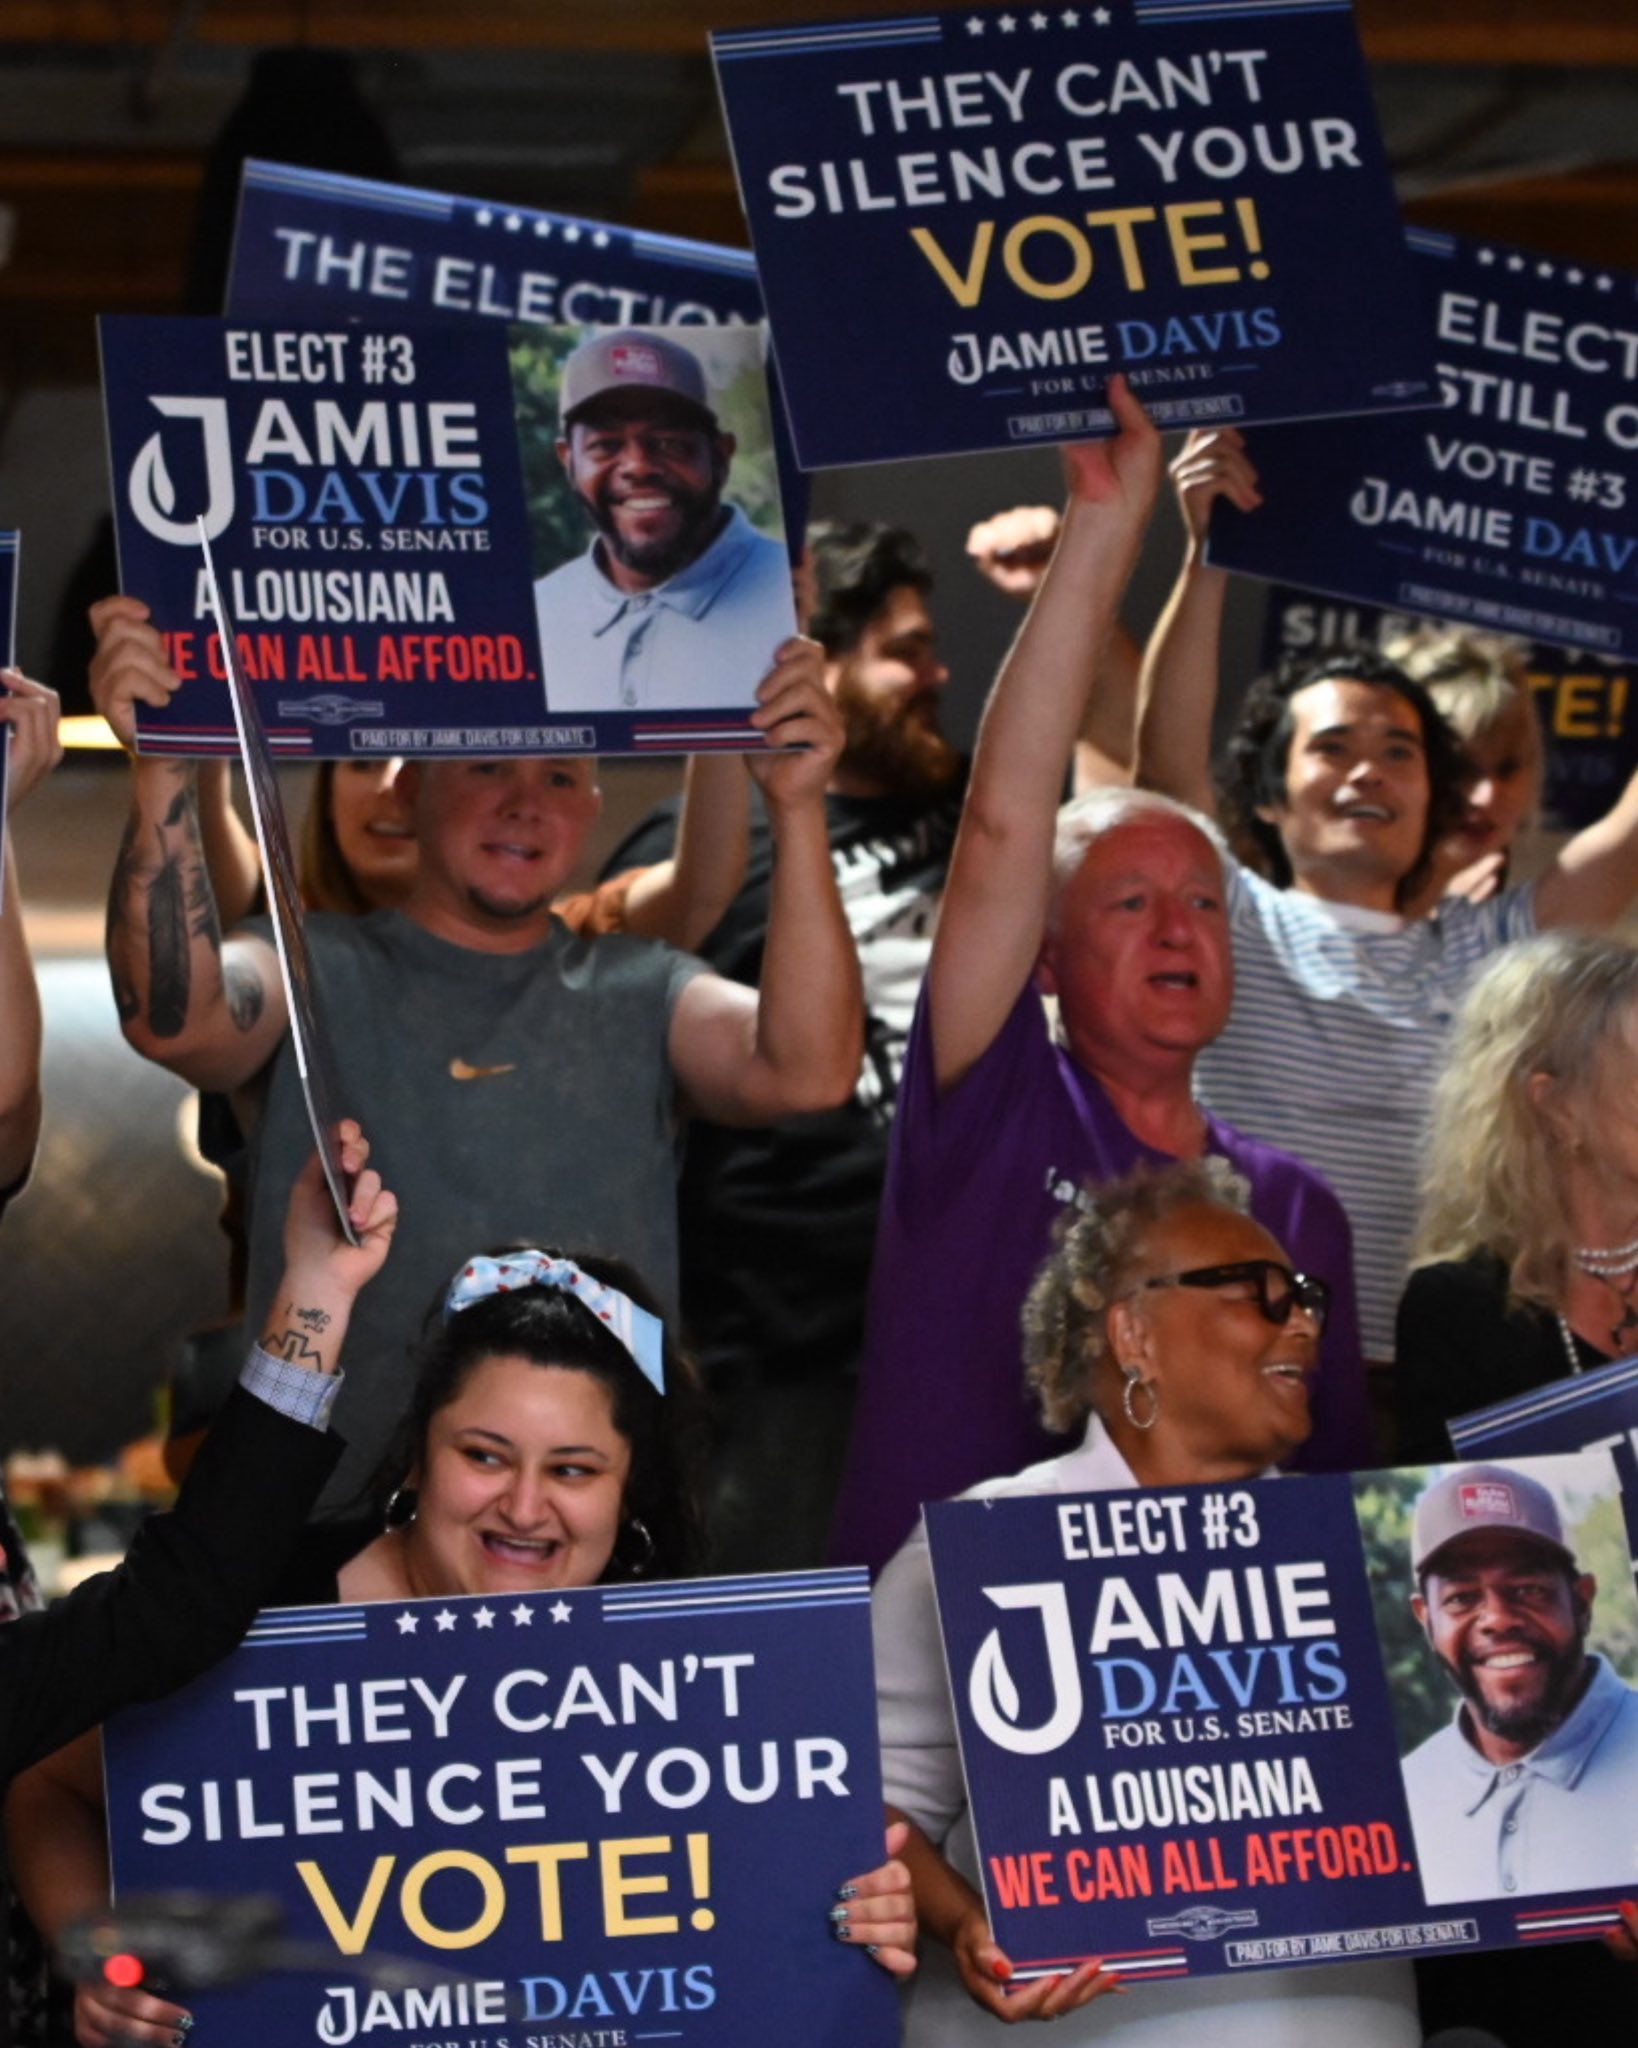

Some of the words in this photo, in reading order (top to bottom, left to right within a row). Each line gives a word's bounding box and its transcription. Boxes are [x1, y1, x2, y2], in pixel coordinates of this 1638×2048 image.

[837, 68, 1032, 137] THEY
[1056, 49, 1268, 116] CAN'T
[768, 138, 1116, 219] SILENCE
[1137, 118, 1362, 183] YOUR
[274, 228, 414, 299] THE
[432, 256, 770, 326] ELECTI
[910, 198, 1271, 308] VOTE!
[225, 331, 347, 384] ELECT
[362, 336, 417, 385] #3
[947, 325, 1109, 384] JAMIE
[1117, 307, 1282, 360] DAVIS
[1030, 379, 1075, 396] FOR
[1128, 364, 1214, 386] SENATE
[129, 395, 483, 547] JAMIE
[249, 470, 491, 526] DAVIS
[1426, 434, 1554, 495] VOTE
[1567, 466, 1626, 510] #3
[252, 527, 318, 550] FOR
[325, 529, 373, 551] U.S.
[381, 530, 491, 552] SENATE
[1350, 476, 1513, 548] JAMIE
[232, 569, 455, 623] LOUISIANA
[1423, 546, 1467, 570] FOR
[1521, 568, 1604, 598] SENATE
[164, 632, 197, 679] E
[296, 634, 368, 682] ALL
[377, 634, 537, 682] AFFORD.
[362, 730, 388, 747] PAID
[390, 730, 411, 747] FOR
[542, 727, 585, 745] SENATE
[1057, 1497, 1188, 1562] ELECT
[1202, 1492, 1261, 1549] #3
[969, 1562, 1337, 1755] JAMIE
[1093, 1641, 1349, 1721] DAVIS
[234, 1674, 467, 1752] THEY
[493, 1653, 755, 1732] CAN'T
[1105, 1720, 1165, 1749] FOR
[1174, 1714, 1230, 1744] U.S.
[1237, 1706, 1354, 1739] SENATE
[139, 1758, 547, 1847] SILENCE
[581, 1737, 852, 1814] YOUR
[1048, 1778, 1082, 1837] A
[1086, 1757, 1323, 1833] LOUISIANA
[295, 1832, 717, 1957] VOTE!
[991, 1853, 1059, 1910] WE
[1066, 1843, 1154, 1900] CAN
[1162, 1838, 1237, 1894] ALL
[1246, 1822, 1412, 1886] AFFORD.
[1236, 1943, 1264, 1962] PAID
[1266, 1941, 1289, 1959] FOR
[1292, 1939, 1307, 1957] BY
[1310, 1935, 1343, 1955] JAMIE
[1345, 1931, 1380, 1951] DAVIS
[1382, 1928, 1402, 1947] FOR
[1405, 1927, 1421, 1944] US
[1422, 1922, 1469, 1943] SENATE
[316, 1981, 506, 2046] JAMIE
[519, 1965, 717, 2023] DAVIS
